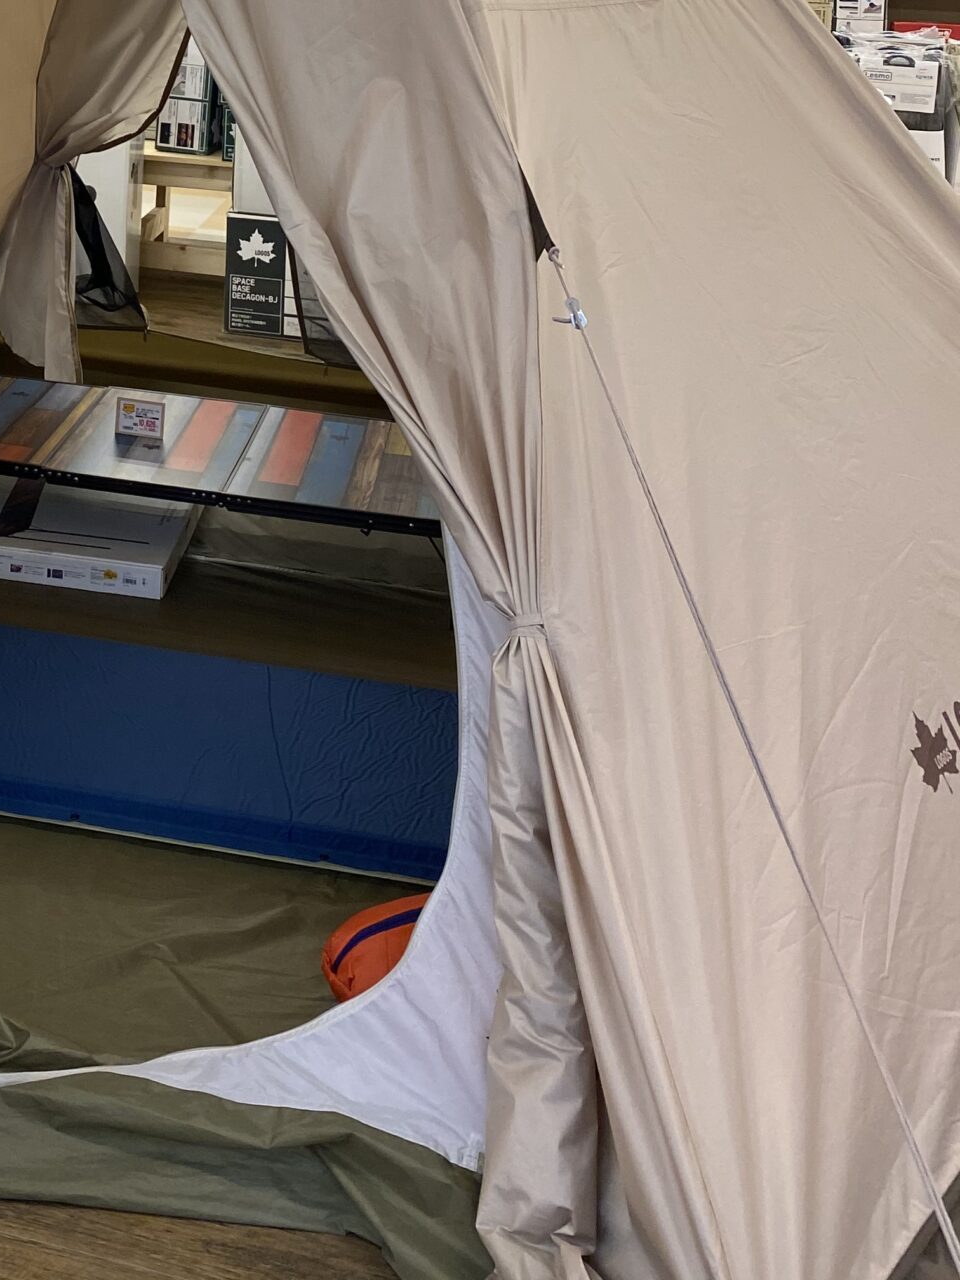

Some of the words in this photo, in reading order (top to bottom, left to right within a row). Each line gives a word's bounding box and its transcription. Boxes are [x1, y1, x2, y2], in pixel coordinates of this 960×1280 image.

[232, 277, 255, 287] SPACE
[232, 285, 251, 293] BASE
[232, 292, 279, 304] DECAGON-BJ
